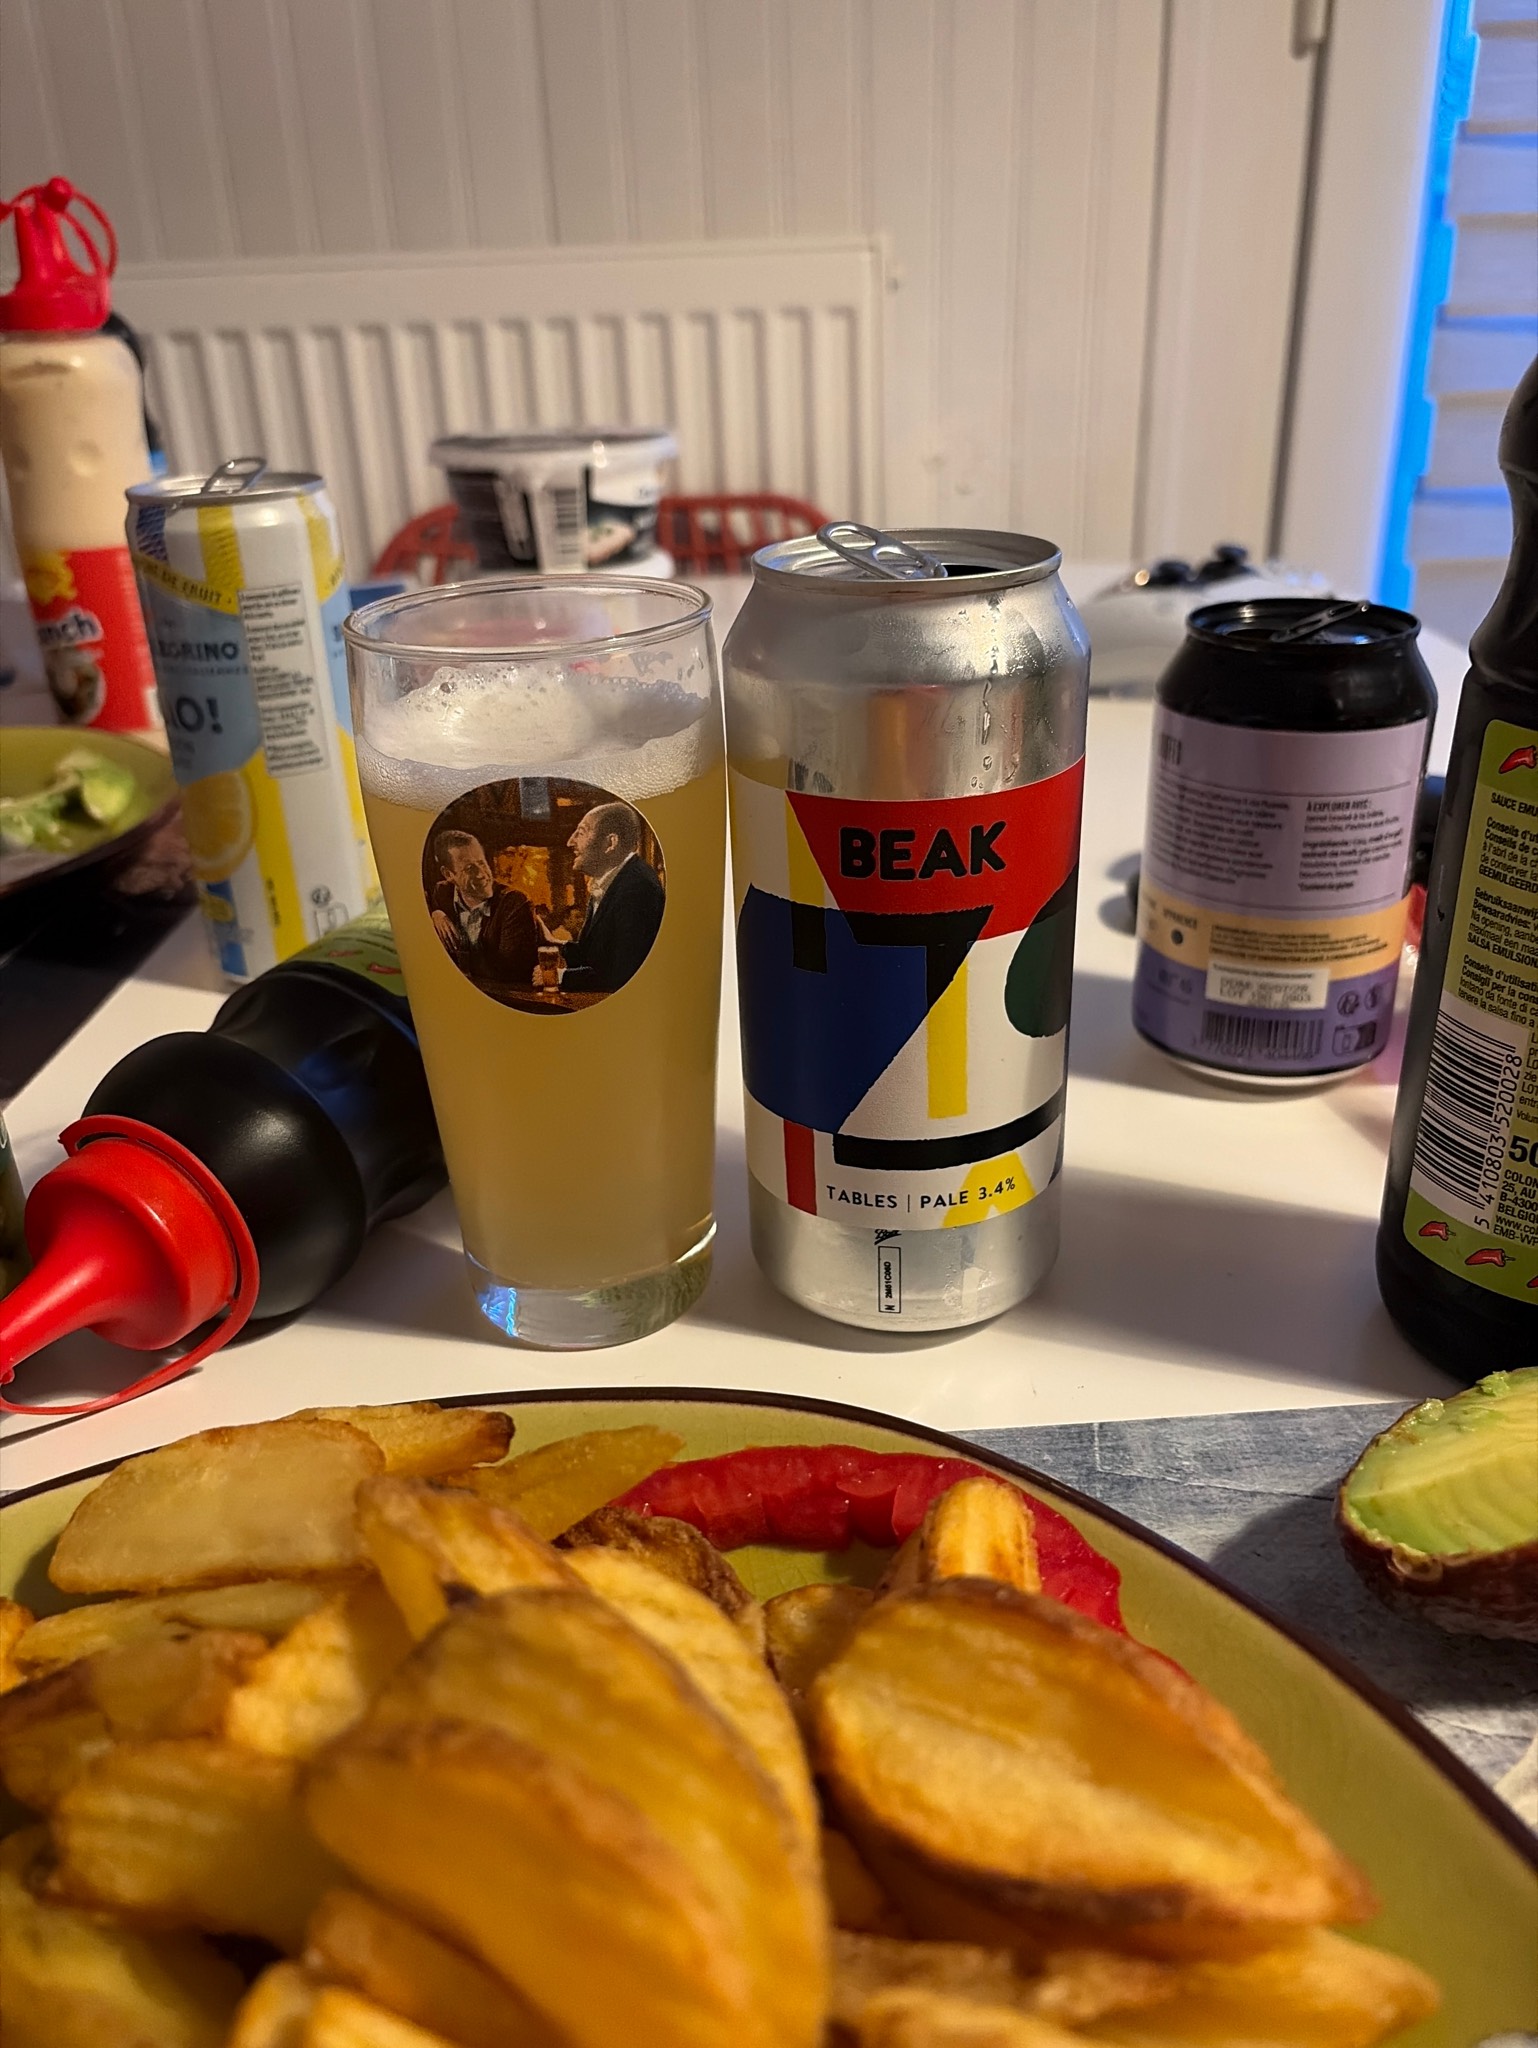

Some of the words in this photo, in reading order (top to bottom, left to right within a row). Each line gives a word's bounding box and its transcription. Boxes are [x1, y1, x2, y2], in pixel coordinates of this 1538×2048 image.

[1491, 792, 1517, 811] SAUCE
[1486, 817, 1519, 837] Conseils
[839, 820, 1007, 881] BEAK
[1485, 829, 1517, 849] Conseils
[1519, 843, 1530, 853] de
[1480, 853, 1489, 864] de
[1490, 858, 1528, 878] conserver
[1530, 870, 1538, 881] la
[1508, 851, 1518, 862] de
[1520, 854, 1528, 866] la
[1471, 910, 1480, 922] Na
[1467, 932, 1490, 951] SALSA
[1504, 938, 1518, 950] een
[1464, 954, 1493, 976] Conseils
[1462, 966, 1491, 987] Consigli
[1491, 982, 1506, 994] per
[1508, 985, 1515, 997] la
[1458, 987, 1479, 1006] tenere
[1480, 998, 1487, 1010] la
[1488, 1003, 1509, 1019] salsa
[1511, 1011, 1526, 1025] fino
[1529, 1018, 1535, 1028] a
[1485, 990, 1495, 1001] da
[1497, 994, 1517, 1009] fonte
[1519, 1002, 1527, 1013] di
[1524, 1071, 1537, 1083] zie
[1494, 1054, 1522, 1128] 520028
[1479, 1133, 1507, 1206] 410803
[826, 1185, 897, 1209] TABLES
[920, 1190, 969, 1209] PALE
[978, 1176, 1016, 1201] 3.4%
[1502, 1181, 1517, 1197] 25,
[1520, 1187, 1537, 1199] AU
[1500, 1191, 1538, 1212] B-4300
[1474, 1215, 1490, 1229] 5
